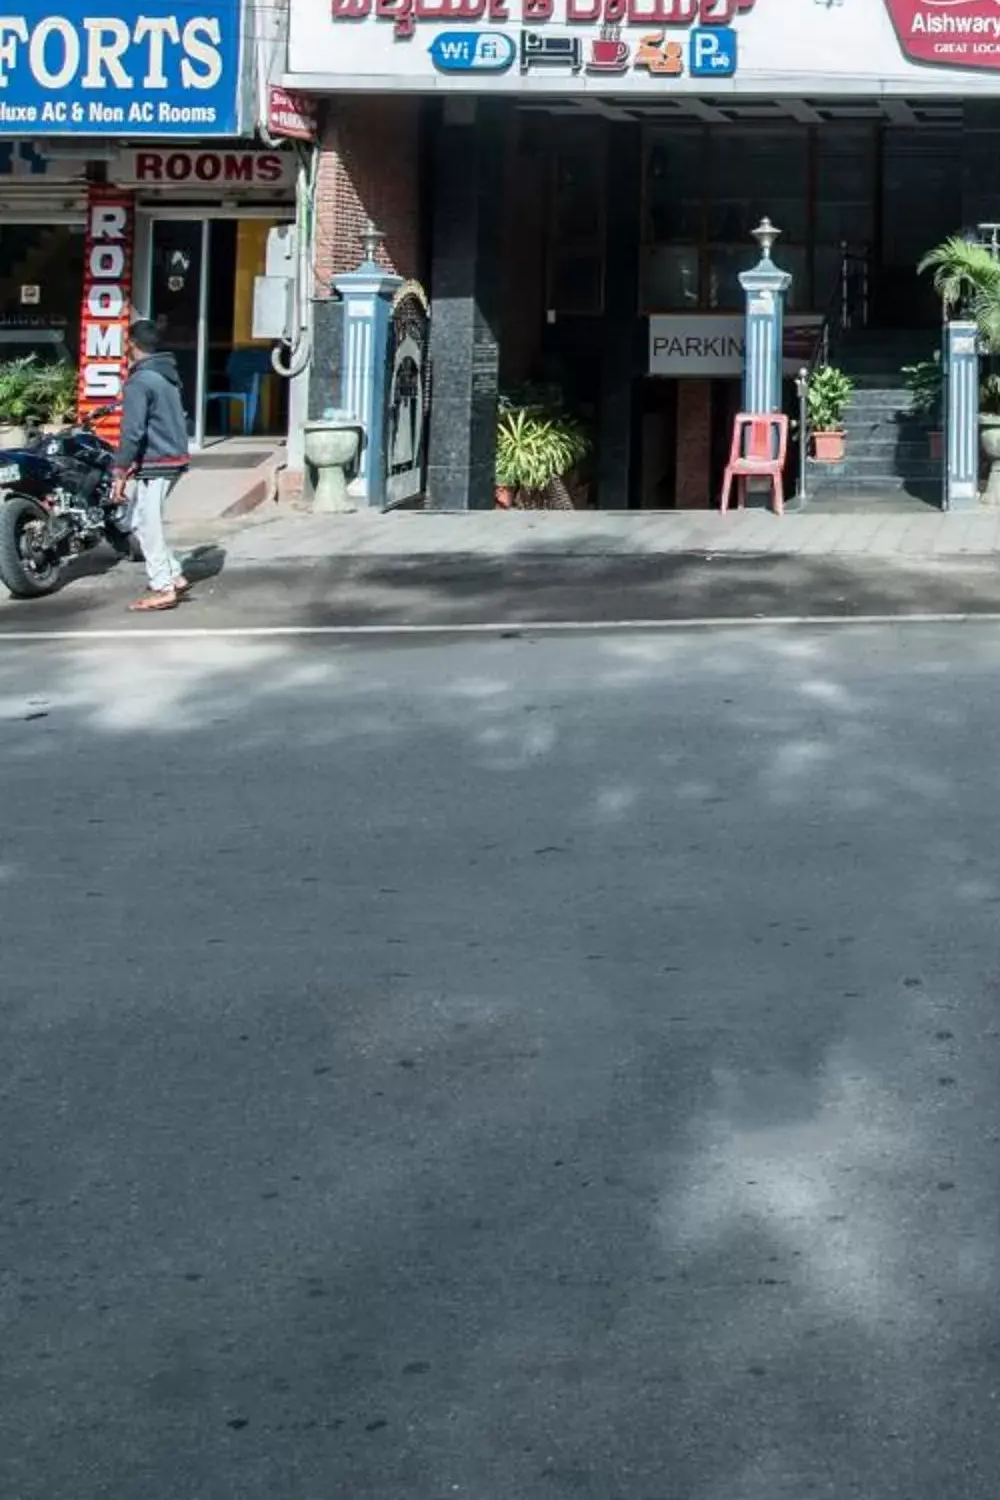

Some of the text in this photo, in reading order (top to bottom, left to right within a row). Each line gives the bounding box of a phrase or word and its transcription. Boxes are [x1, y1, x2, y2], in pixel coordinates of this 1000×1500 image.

[0, 16, 223, 90] FORTS
[440, 41, 469, 60] Wi
[934, 43, 968, 54] GREAT
[42, 102, 67, 122] AC
[72, 102, 84, 122] &
[89, 103, 124, 122] Non
[128, 102, 154, 122] AC
[159, 102, 216, 123] Rooms
[135, 154, 284, 182] ROOMS
[84, 204, 128, 399] ROOMS
[653, 336, 743, 357] PARKIN
